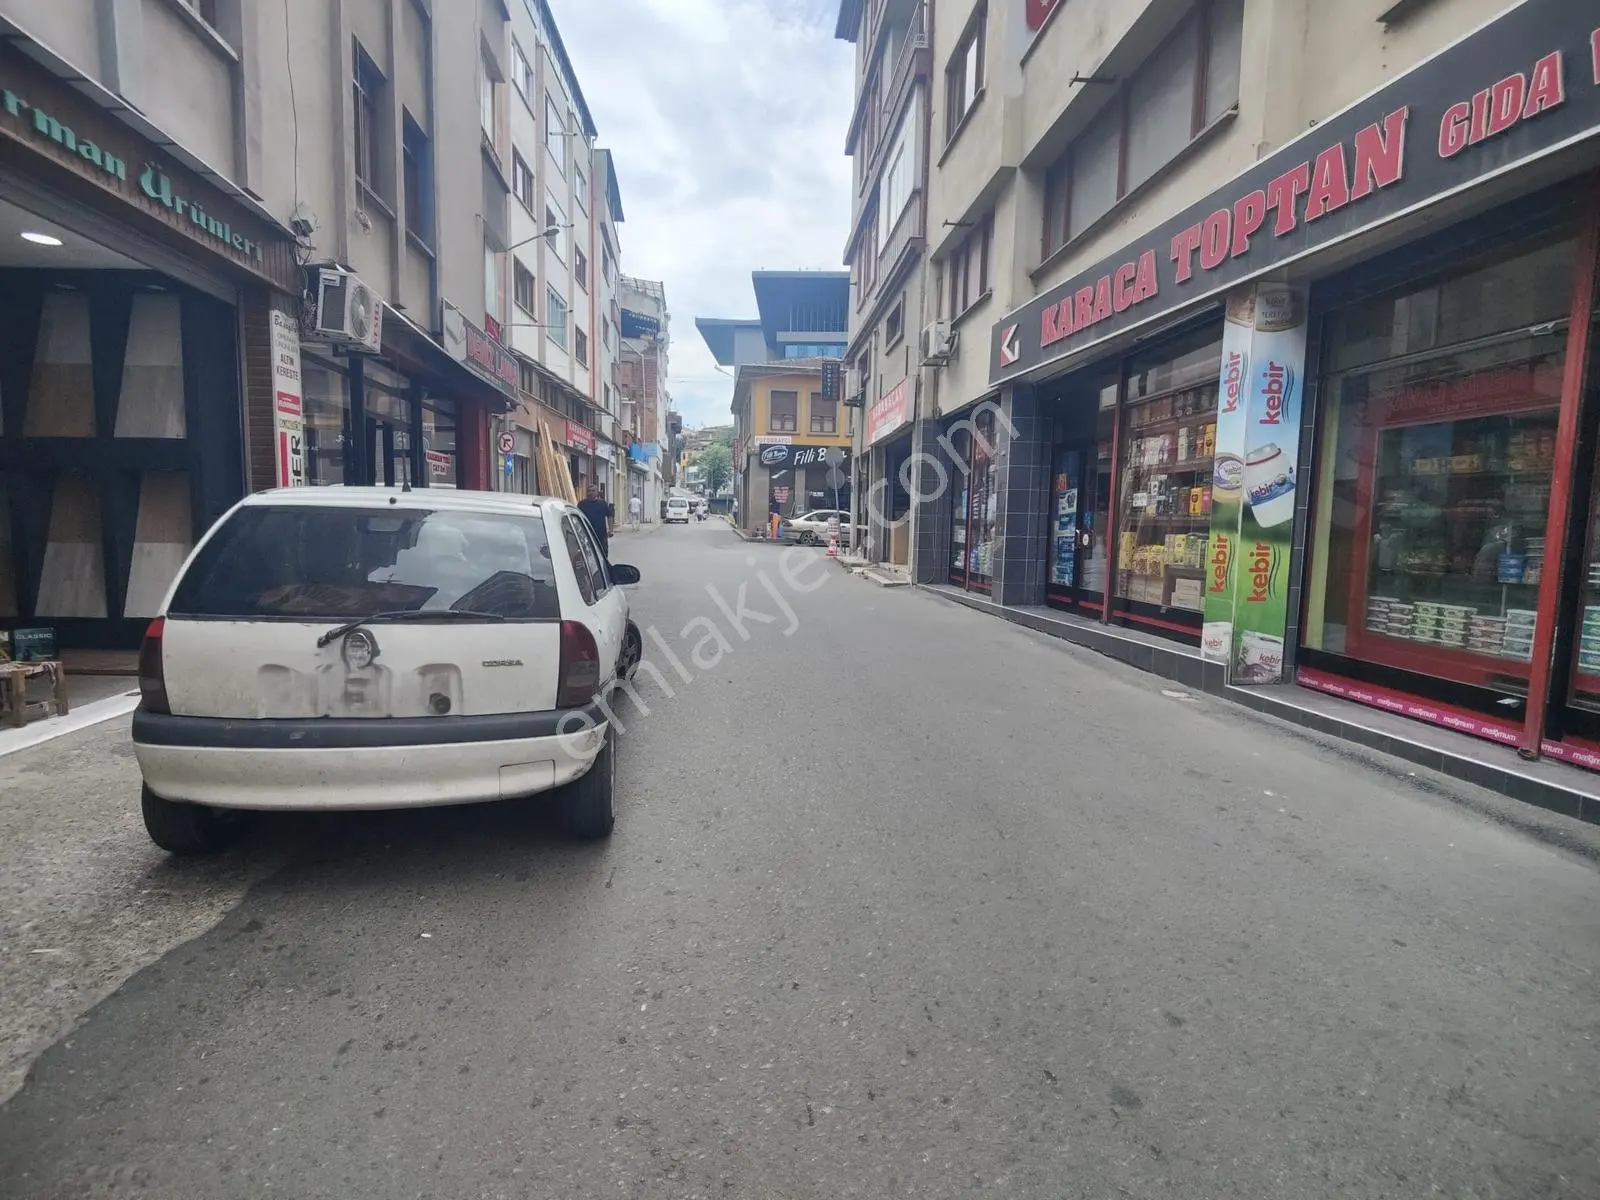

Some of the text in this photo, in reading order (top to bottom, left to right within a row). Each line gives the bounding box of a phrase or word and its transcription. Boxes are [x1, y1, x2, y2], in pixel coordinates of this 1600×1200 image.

[1040, 249, 1158, 347] KARACA
[1170, 105, 1410, 284] TOPTAN
[1438, 50, 1563, 158] GIDA
[1222, 351, 1241, 413] kebir
[1260, 360, 1284, 425] kebir
[793, 448, 815, 466] Filli
[1250, 482, 1274, 498] kebir
[1209, 533, 1228, 593] kebir
[1247, 541, 1270, 603] kebir
[1259, 652, 1281, 665] kebir
